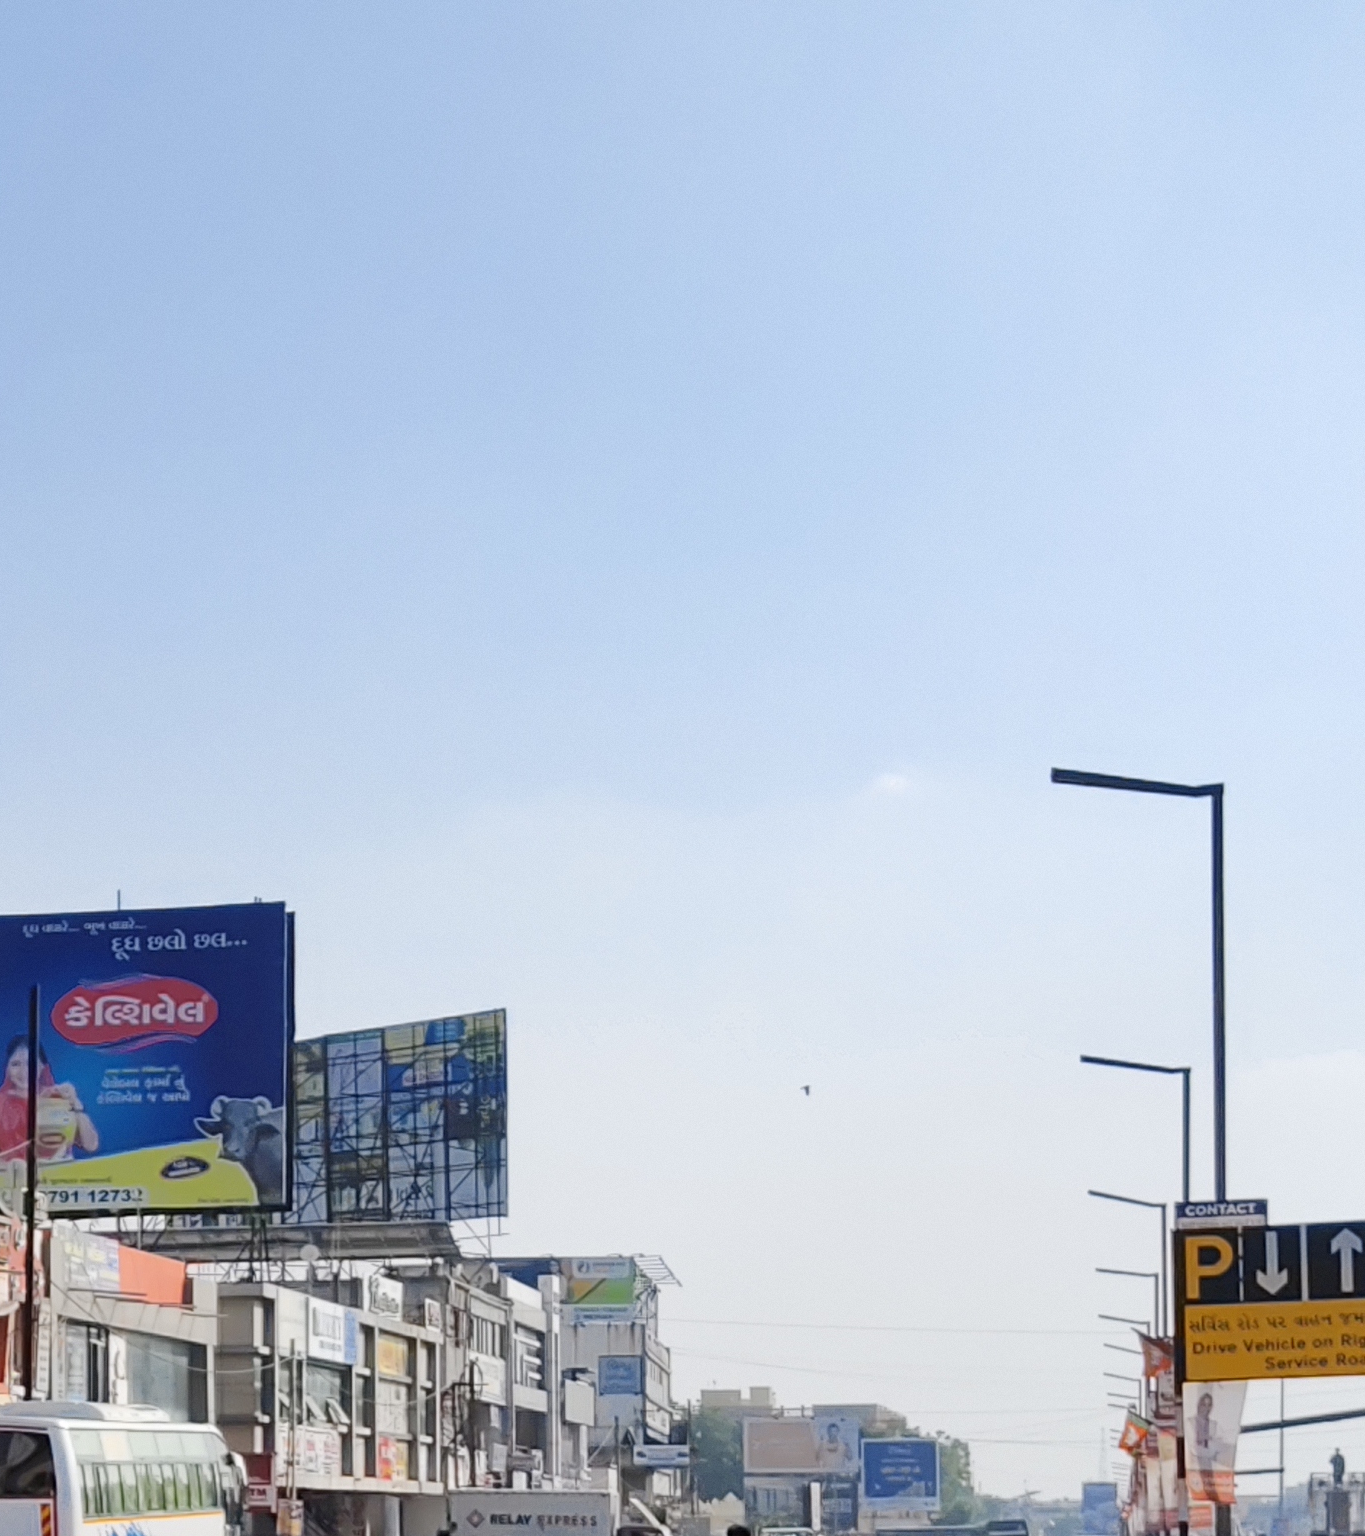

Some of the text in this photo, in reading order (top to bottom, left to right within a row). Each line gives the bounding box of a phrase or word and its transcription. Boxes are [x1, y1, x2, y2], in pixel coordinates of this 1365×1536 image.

[1184, 1202, 1257, 1217] CONTACT
[1185, 1235, 1234, 1300] P
[1192, 1342, 1237, 1355] Drive
[1242, 1337, 1306, 1353] Vehicle
[1312, 1338, 1334, 1349] on
[1264, 1356, 1328, 1371] Service
[490, 1513, 532, 1525] RELAY
